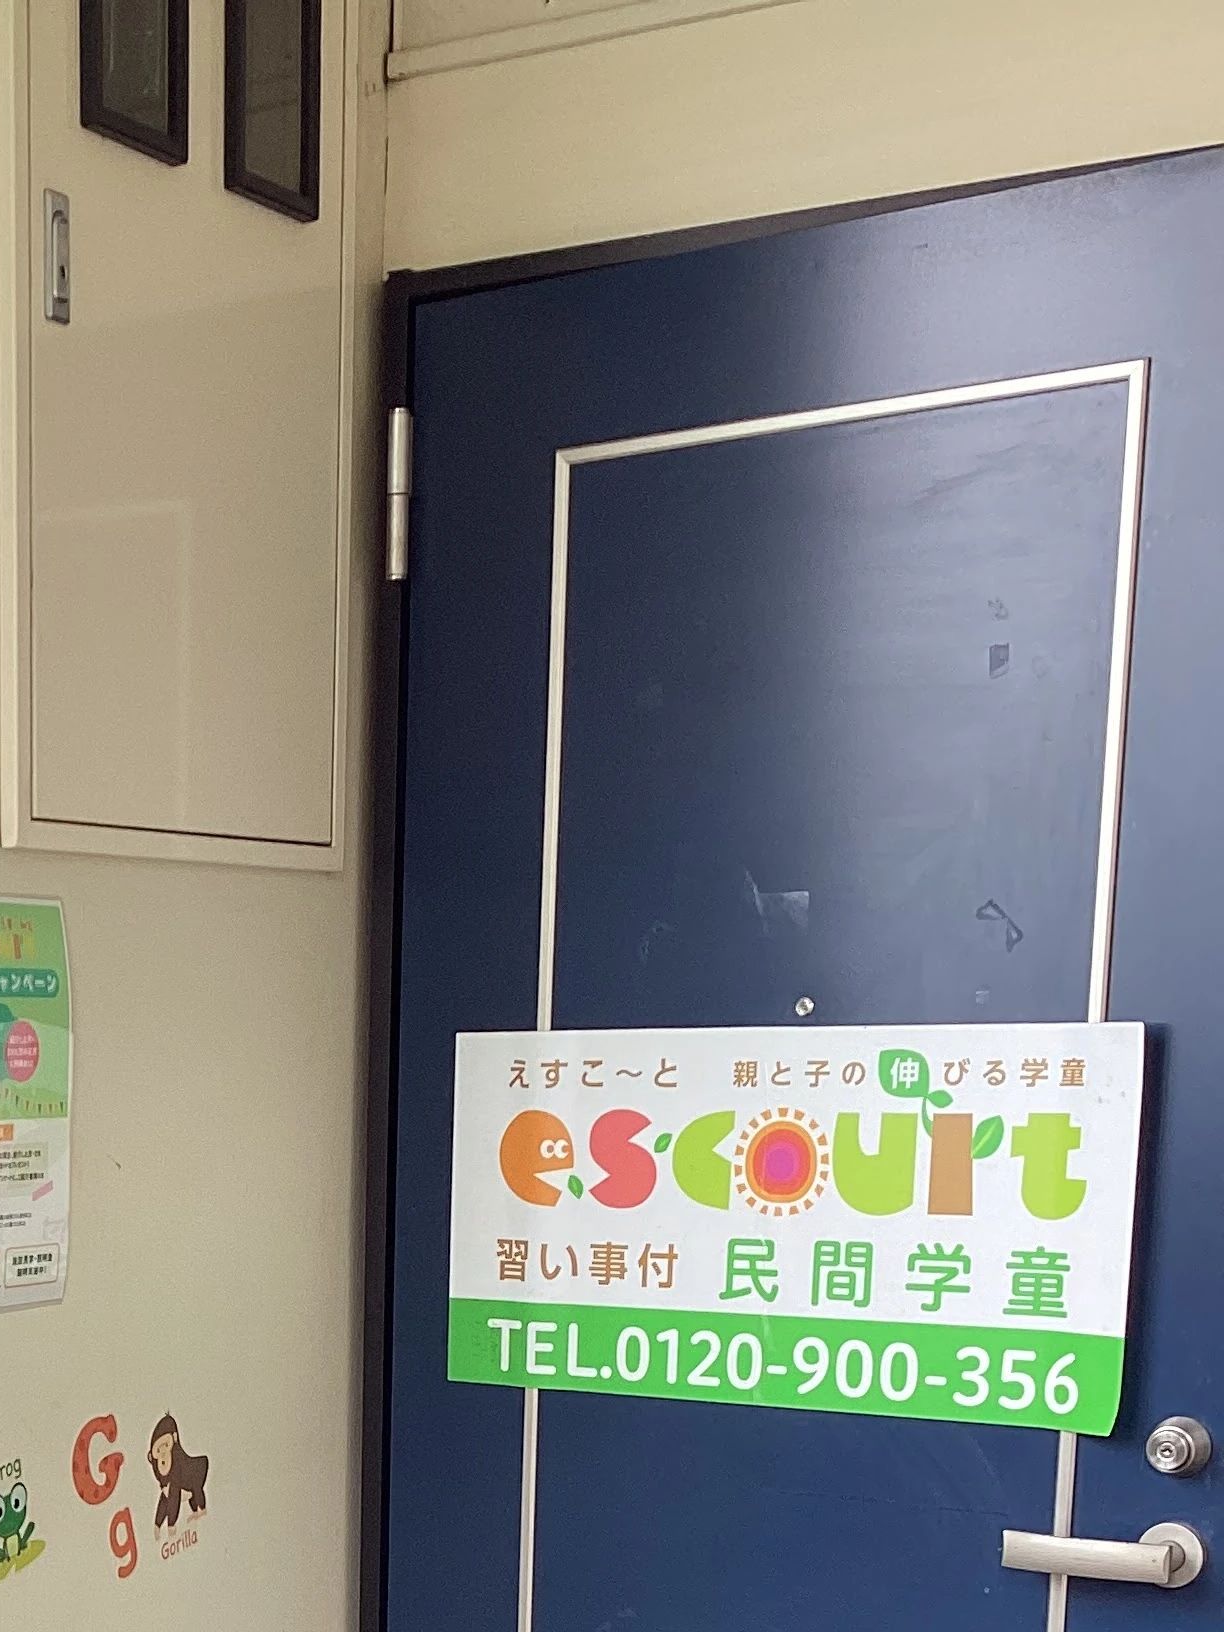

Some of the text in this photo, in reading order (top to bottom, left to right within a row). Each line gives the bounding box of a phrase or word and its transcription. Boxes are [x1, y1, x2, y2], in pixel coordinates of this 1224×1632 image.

[732, 1054, 1087, 1090] 親と子の伸びる学童
[498, 1107, 1088, 1221] escourt
[497, 1237, 1072, 1320] 習い事付 民間学童
[486, 1316, 1080, 1416] TEL.0120-900-356
[72, 1413, 125, 1506] G
[160, 1529, 199, 1560] Gorilla
